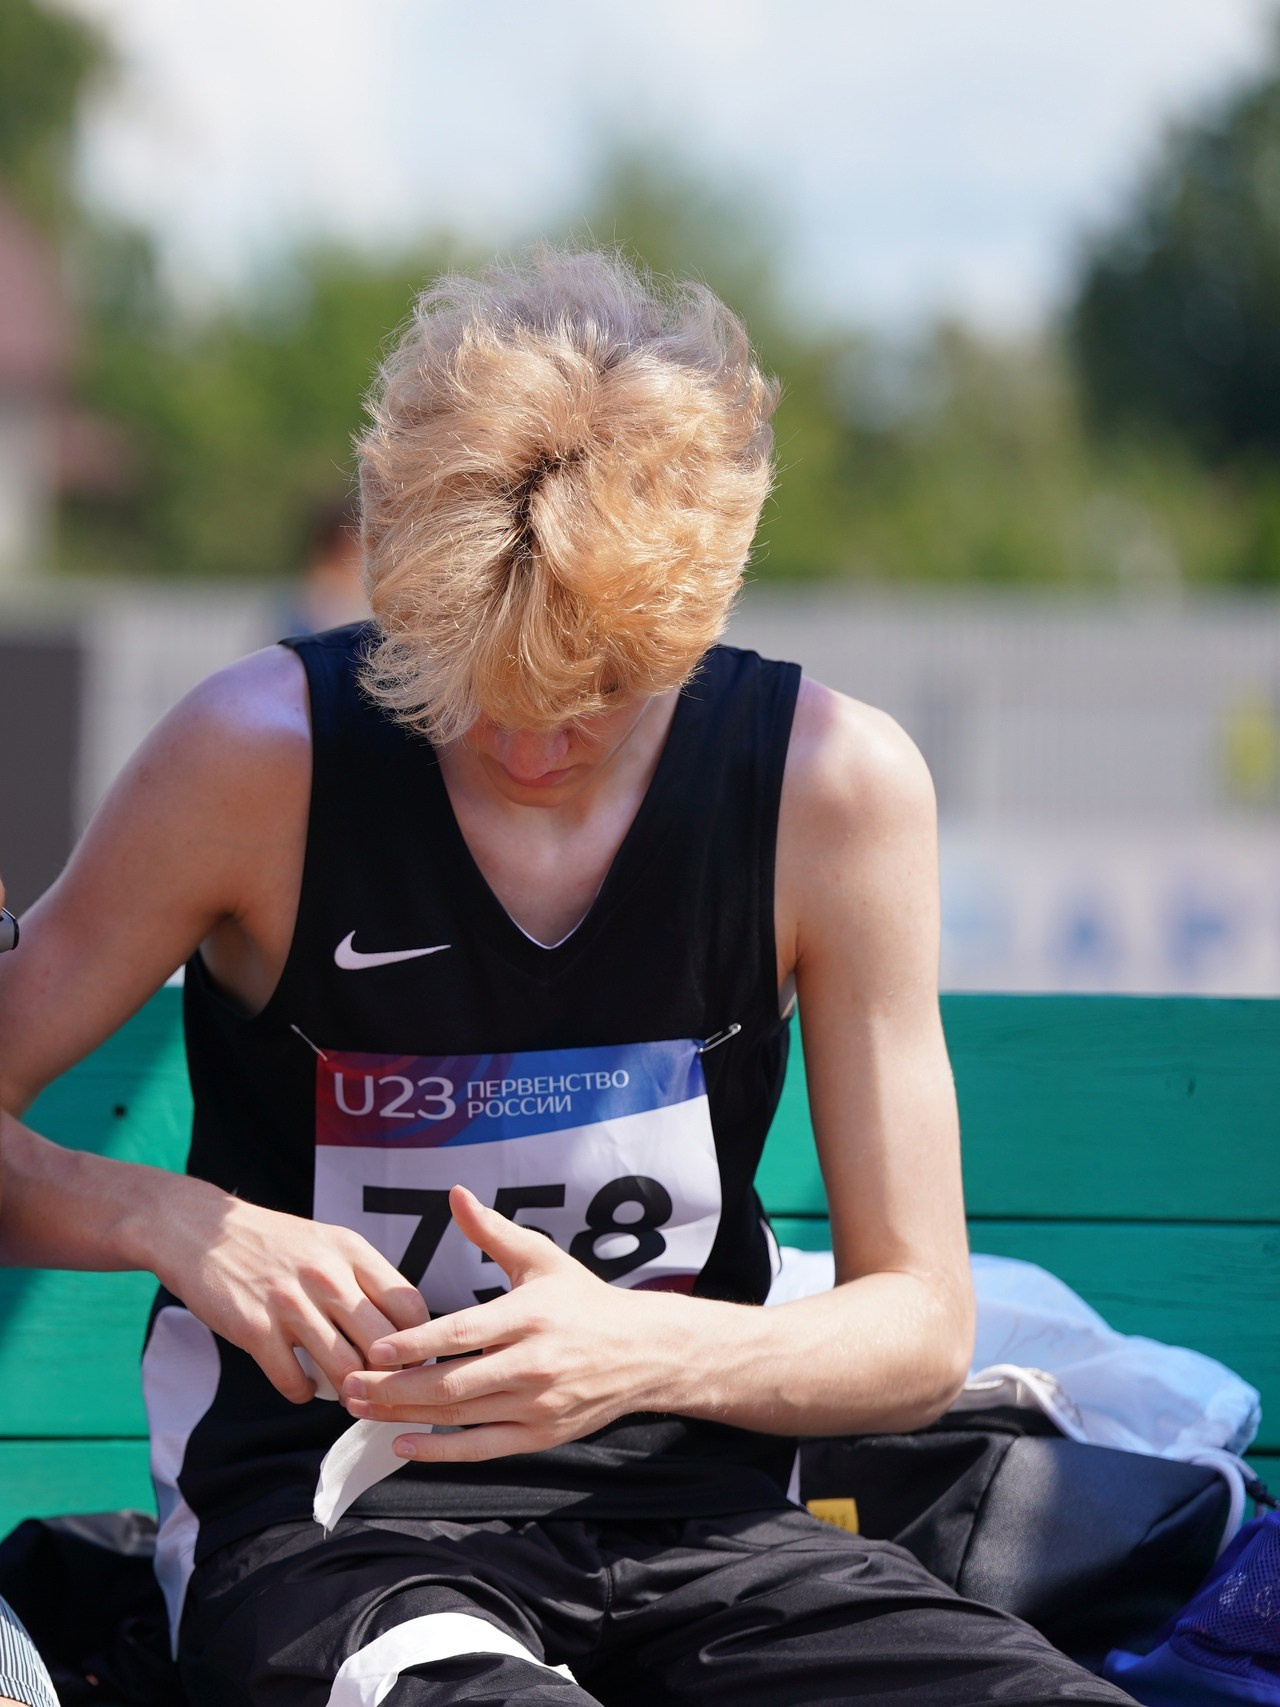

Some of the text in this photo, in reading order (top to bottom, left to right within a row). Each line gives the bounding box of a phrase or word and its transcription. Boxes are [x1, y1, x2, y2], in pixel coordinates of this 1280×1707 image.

[334, 1072, 456, 1120] U23
[467, 1069, 630, 1099] ПЕРВЕНСТВО
[467, 1094, 571, 1119] РОССИИ
